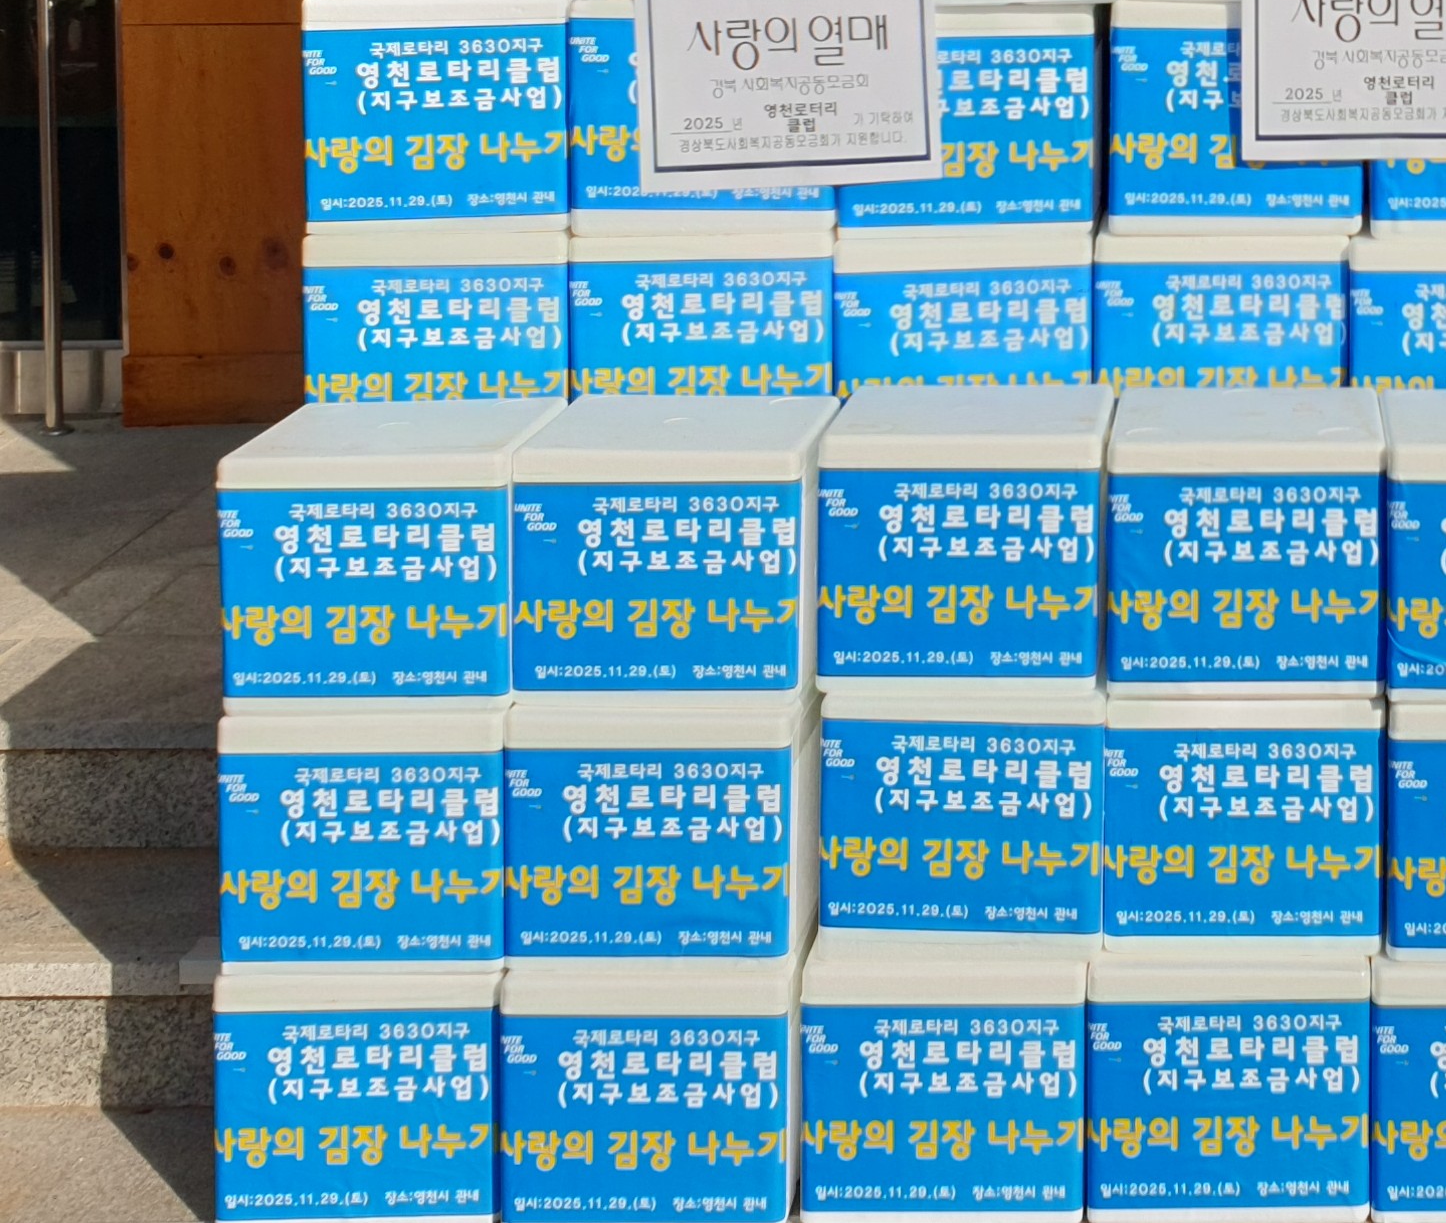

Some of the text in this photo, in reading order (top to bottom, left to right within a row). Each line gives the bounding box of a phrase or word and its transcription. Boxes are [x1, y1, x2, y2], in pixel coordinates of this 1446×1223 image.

[369, 37, 544, 60] 국제로타리 3630지구
[687, 14, 888, 71] 사랑의 열매
[1312, 50, 1338, 70] 경북
[356, 57, 560, 89] 영천로타리클럽
[710, 78, 737, 99] 경북
[1363, 76, 1435, 91] 영천로터리
[357, 86, 561, 115] (지구보조금사업)
[1285, 88, 1324, 101] 2025
[1385, 91, 1413, 106] 클럽
[764, 102, 838, 118] 영천로터리
[683, 117, 723, 131] 2025
[787, 118, 817, 133] 클럽
[305, 134, 393, 174] 사랑의
[405, 132, 469, 171] 김장
[533, 192, 555, 204] 관내
[514, 503, 543, 513] UNITE
[593, 496, 780, 516] 국제로타리 3630지구
[523, 513, 544, 522] FOR
[526, 522, 557, 532] GOOD
[578, 517, 796, 548] 영천로타리클럽
[578, 549, 797, 576] (지구보조금사업)
[513, 598, 614, 640] 사랑의
[628, 598, 696, 639] 김장
[763, 665, 786, 678] 관내
[1174, 743, 1357, 762] 국제로타리 3630지구
[1106, 758, 1127, 767] FOR
[1109, 768, 1139, 777] GOOD
[1159, 763, 1373, 795] 영천로타리클럽
[1159, 795, 1373, 822] (지구보조금사업)
[1104, 843, 1382, 885] 사랑의 김장 나누기
[1340, 911, 1363, 924] 관내
[874, 1019, 1060, 1038] 국제로타리 3630지구
[805, 1034, 826, 1043] FOR
[808, 1044, 838, 1053] GOOD
[859, 1039, 1076, 1071] 영천로타리클럽
[859, 1071, 1076, 1098] (지구보조금사업)
[803, 1119, 1084, 1161] 사랑의 김장 나누기
[1042, 1187, 1065, 1199] 관내
